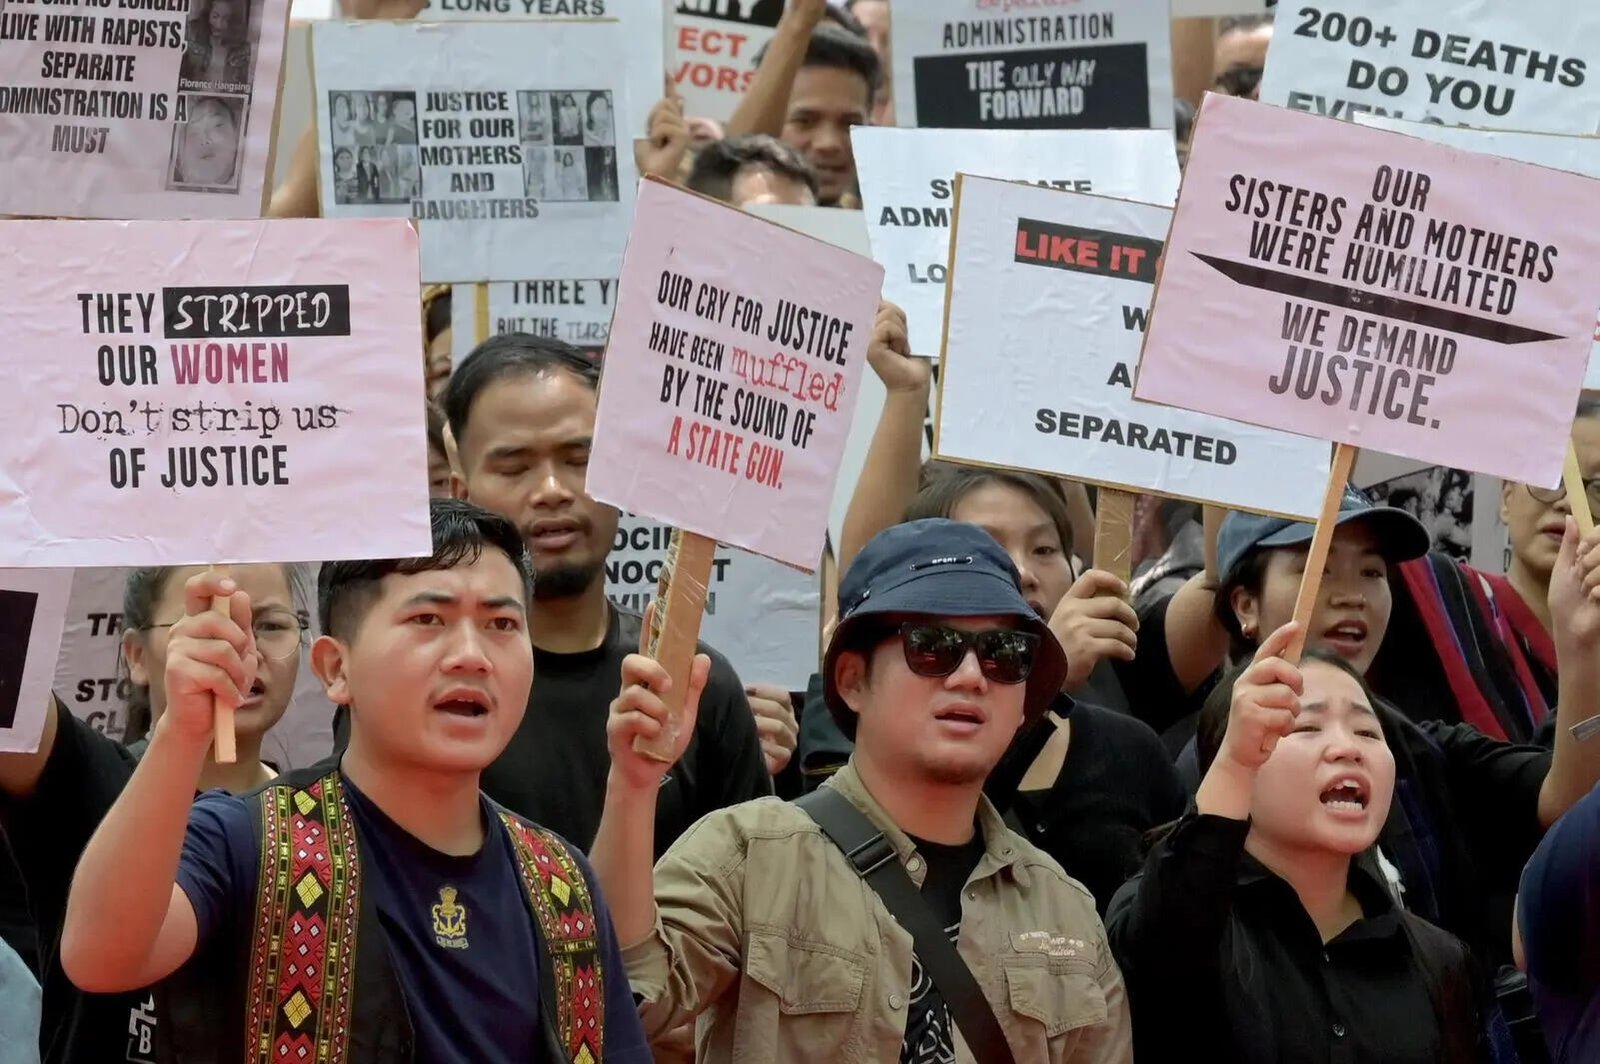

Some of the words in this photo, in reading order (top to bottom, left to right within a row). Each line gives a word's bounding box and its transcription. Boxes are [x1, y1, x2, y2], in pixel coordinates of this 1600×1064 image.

[518, 0, 605, 16] YEARS
[0, 13, 40, 41] LIVE
[44, 14, 96, 44] WITH
[101, 17, 187, 51] RAPISTS,
[942, 12, 1114, 49] ADMINISTRATION
[1293, 7, 1397, 47] 200+
[1411, 28, 1587, 88] DEATHS
[41, 50, 136, 82] SEPARATE
[965, 60, 1006, 91] THE
[1060, 59, 1096, 87] WAY
[0, 87, 143, 120] DMINISTRATION
[149, 92, 168, 121] IS
[174, 94, 188, 122] A
[425, 91, 509, 112] JUSTICE
[979, 85, 1085, 121] FORWARD
[1346, 59, 1409, 97] DO
[1425, 72, 1516, 116] YOU
[51, 124, 110, 154] MUST
[423, 118, 462, 139] FOR
[470, 117, 515, 139] OUR
[420, 144, 523, 166] MOTHERS
[450, 172, 495, 193] AND
[1371, 164, 1431, 212] OUR
[412, 197, 540, 220] DAUGHTERS
[1225, 173, 1347, 235] SISTERS
[1353, 204, 1415, 250] AND
[1424, 218, 1559, 283] MOTHERS
[1015, 229, 1100, 268] LIKE
[1109, 244, 1146, 275] IT
[1249, 220, 1336, 275] WERE
[1342, 247, 1518, 316] HUMILIATED
[77, 292, 155, 334] THEY
[173, 291, 331, 333] STRIPPED
[512, 280, 586, 305] THREE
[531, 317, 560, 339] THE
[657, 270, 693, 313] OUR
[695, 283, 730, 323] CRY
[731, 295, 763, 336] FOR
[768, 299, 853, 366] JUSTICE
[1280, 301, 1331, 348] WE
[1336, 315, 1458, 376] DEMAND
[98, 345, 159, 387] OUR
[170, 342, 289, 385] WOMEN
[649, 321, 688, 360] HAVE
[690, 335, 725, 372] BEEN
[731, 346, 845, 413] muffled
[660, 364, 690, 407] BY
[693, 375, 729, 421] THE
[730, 387, 789, 441] SOUND
[791, 408, 817, 450] OF
[1268, 344, 1442, 431] JUSTICE.
[56, 400, 162, 436] Don't
[171, 401, 283, 439] strip
[291, 404, 348, 431] us
[1035, 407, 1238, 466] SEPARATED
[109, 446, 147, 489] OF
[161, 444, 289, 488] JUSTICE
[667, 415, 683, 457] A
[686, 421, 743, 475] STATE
[745, 441, 785, 490] GUN.
